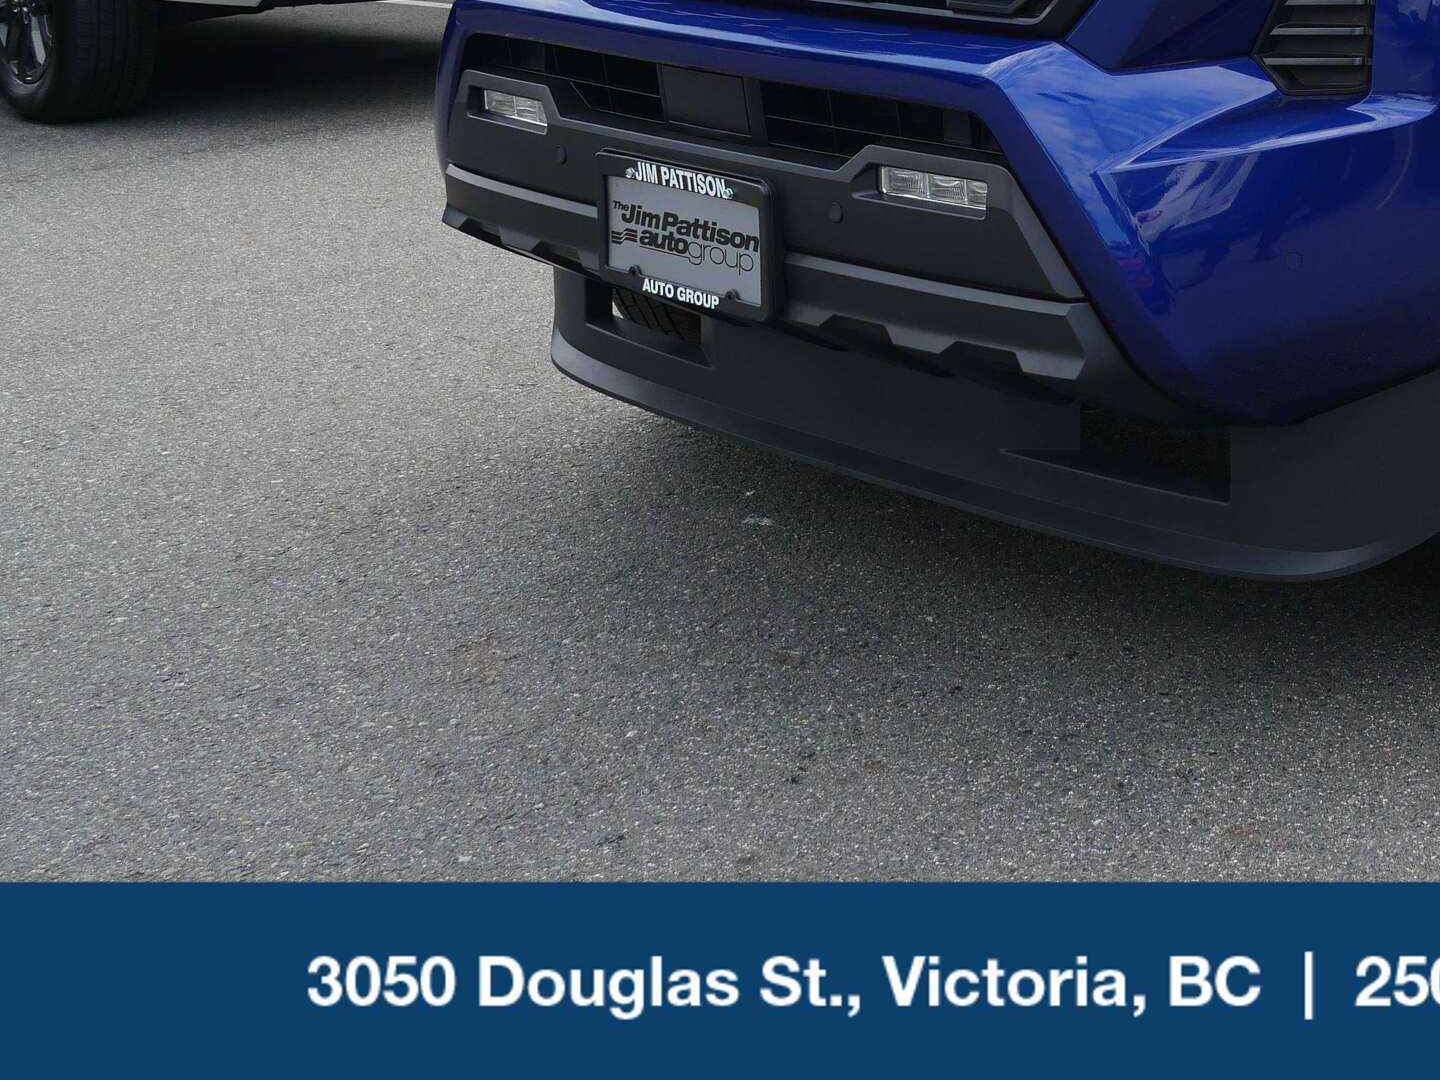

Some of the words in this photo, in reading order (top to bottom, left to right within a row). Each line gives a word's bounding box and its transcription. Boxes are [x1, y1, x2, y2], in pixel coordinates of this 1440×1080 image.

[635, 161, 659, 185] JIM
[660, 166, 727, 199] PATTISON
[612, 200, 629, 211] The
[621, 204, 660, 229] Jim
[661, 212, 760, 252] Pattison
[642, 278, 675, 298] AUTO
[676, 287, 720, 309] GROUP
